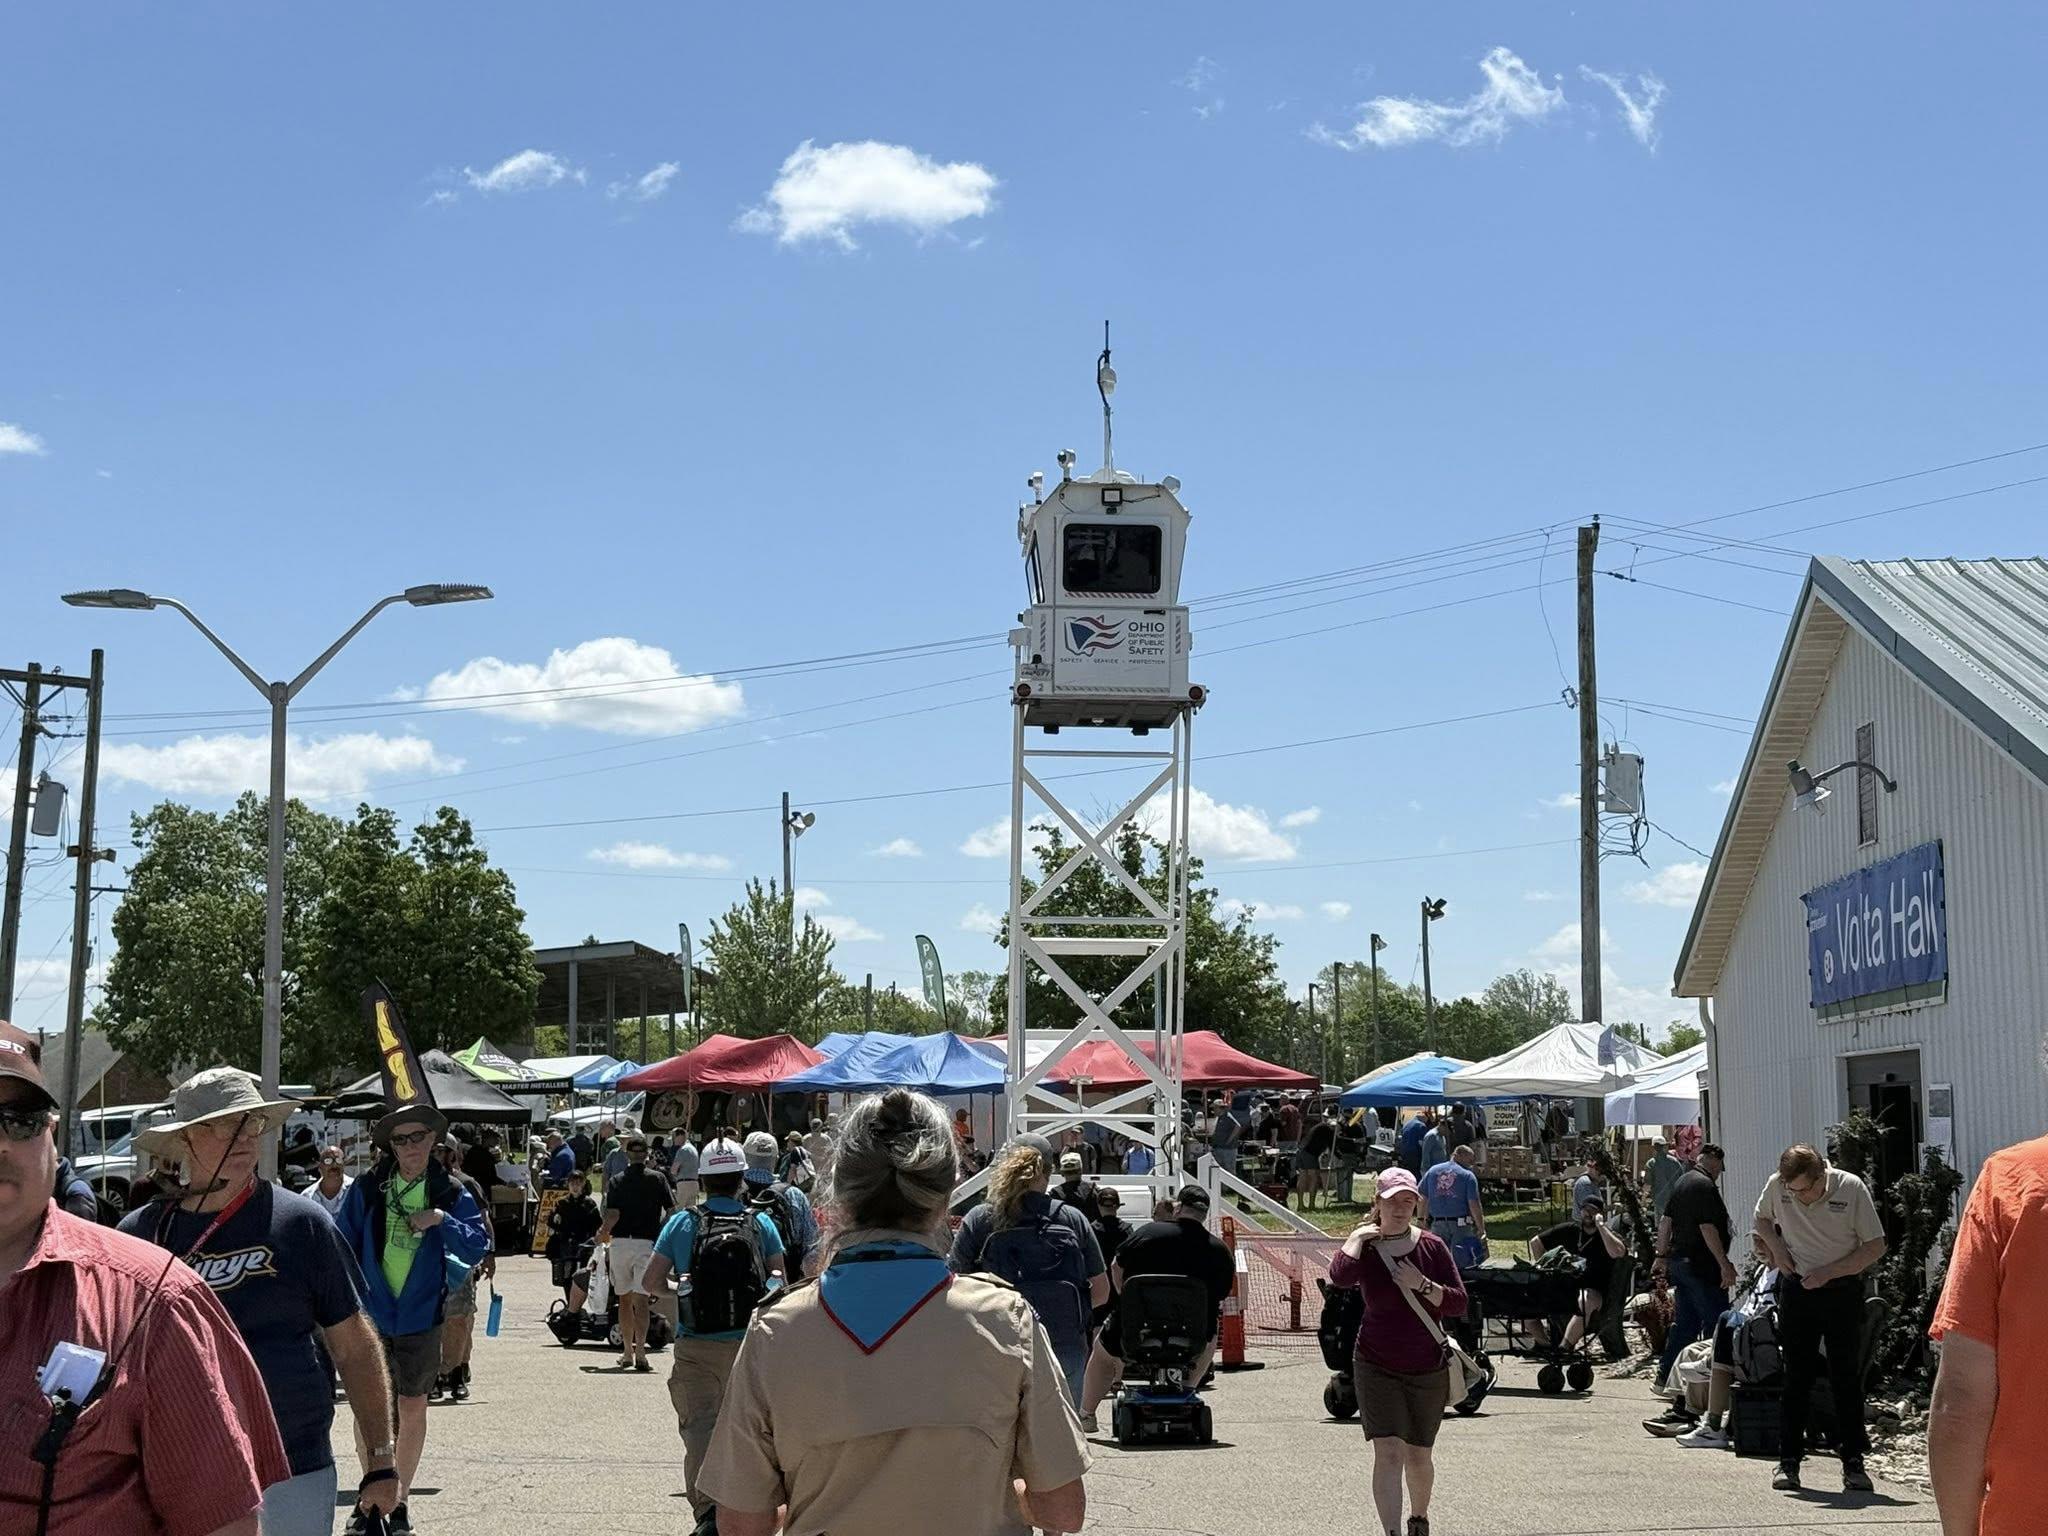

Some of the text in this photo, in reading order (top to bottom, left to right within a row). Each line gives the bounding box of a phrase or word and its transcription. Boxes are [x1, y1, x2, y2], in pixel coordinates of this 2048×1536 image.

[1128, 622, 1165, 632] OHIO
[1128, 646, 1164, 655] SAFETY
[1836, 869, 1938, 974] Volta Hall
[1379, 1132, 1390, 1141] 91
